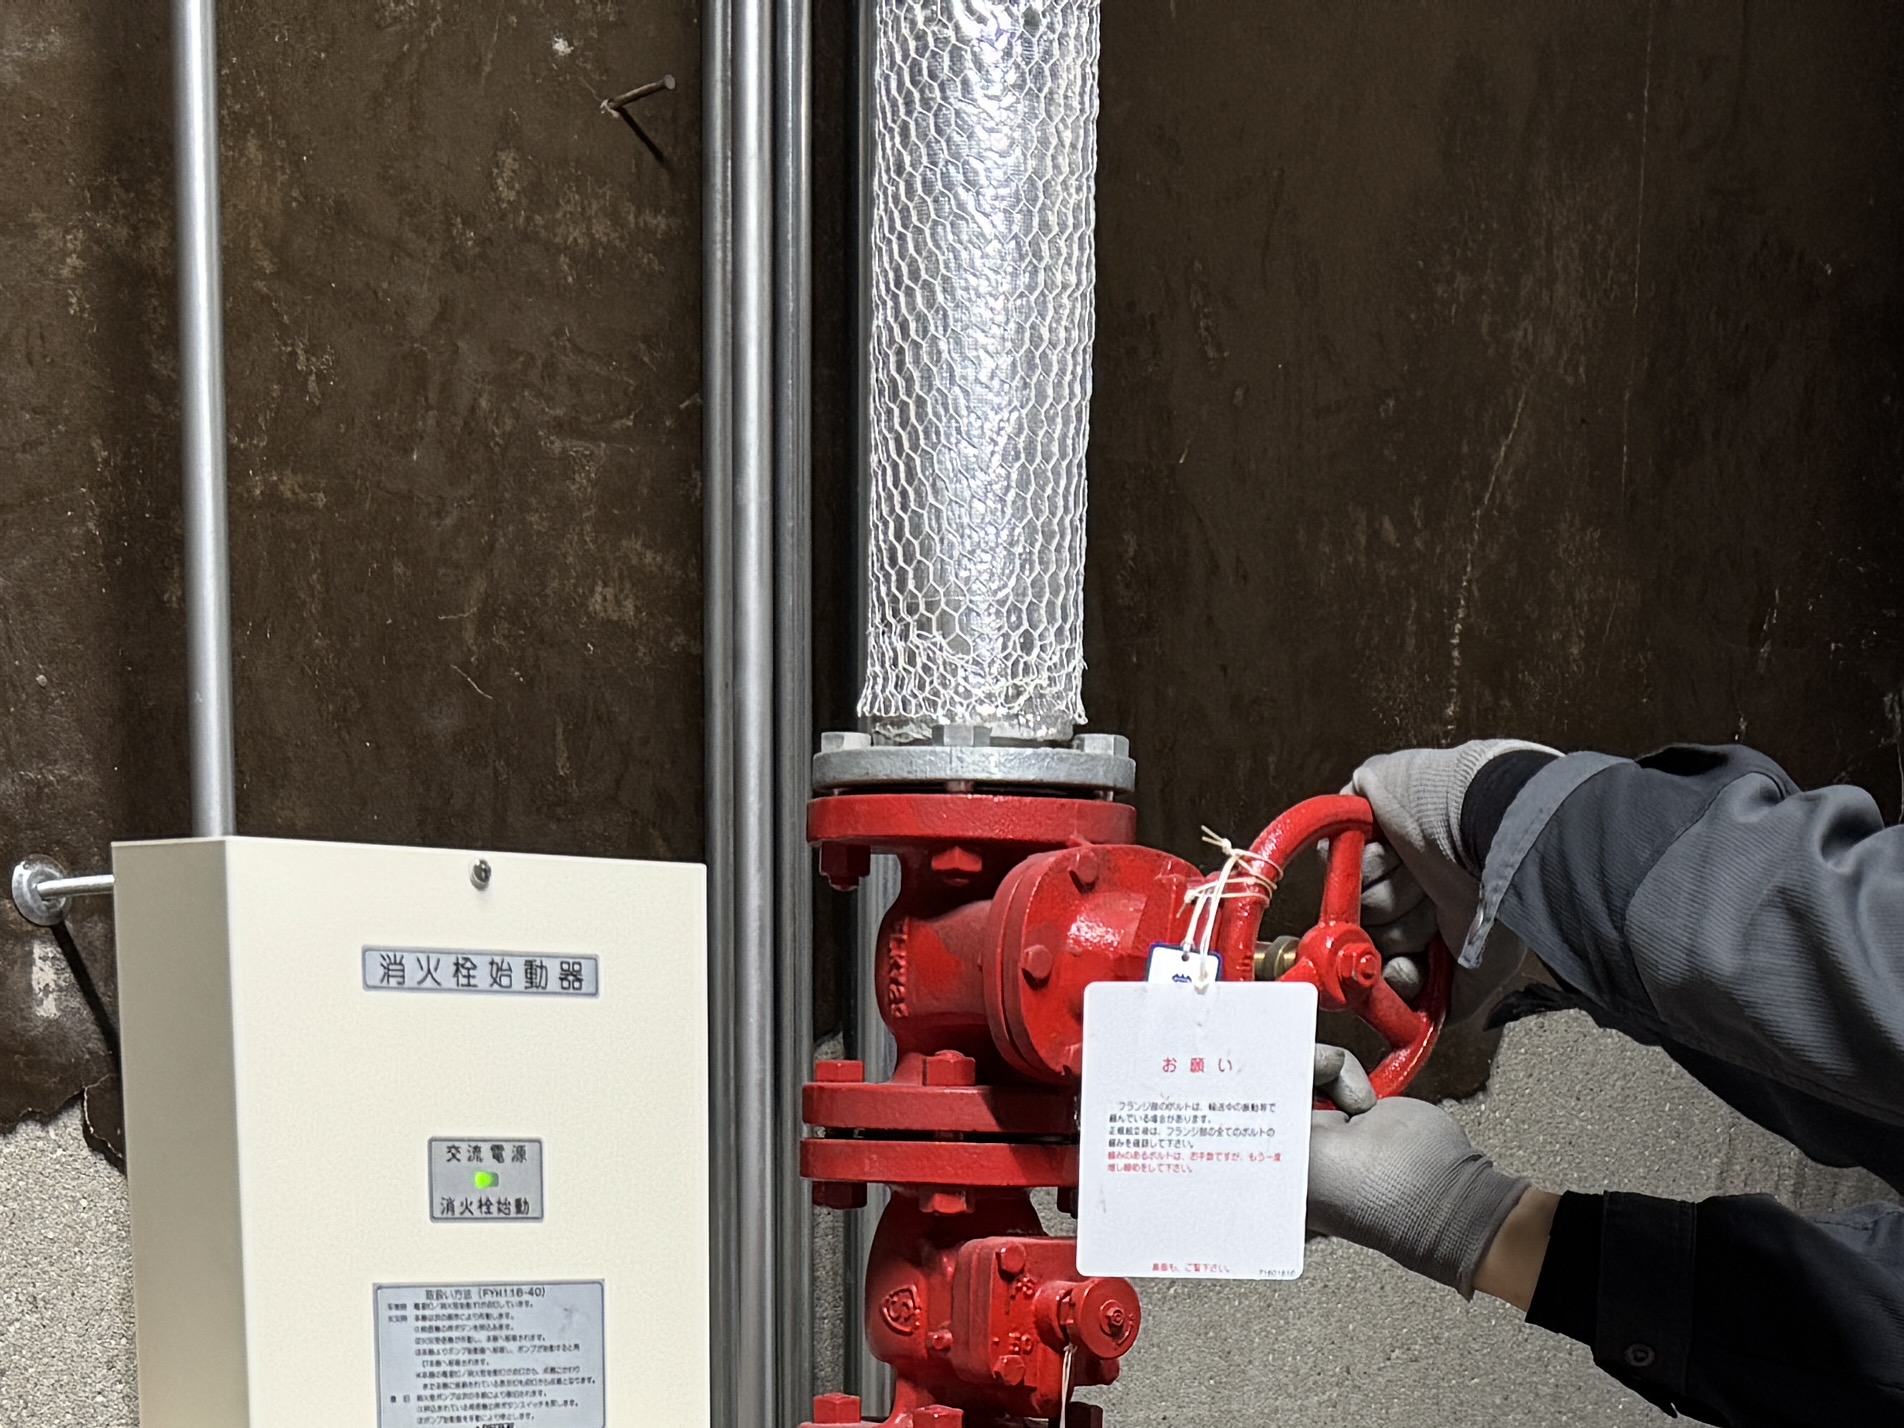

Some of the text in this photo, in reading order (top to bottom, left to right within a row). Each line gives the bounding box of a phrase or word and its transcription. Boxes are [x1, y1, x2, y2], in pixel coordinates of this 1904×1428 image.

[379, 953, 584, 991] 消火栓始動器
[1162, 1057, 1233, 1073] お願い
[446, 1144, 528, 1164] 交流電源
[440, 1197, 531, 1217] 消火栓始動
